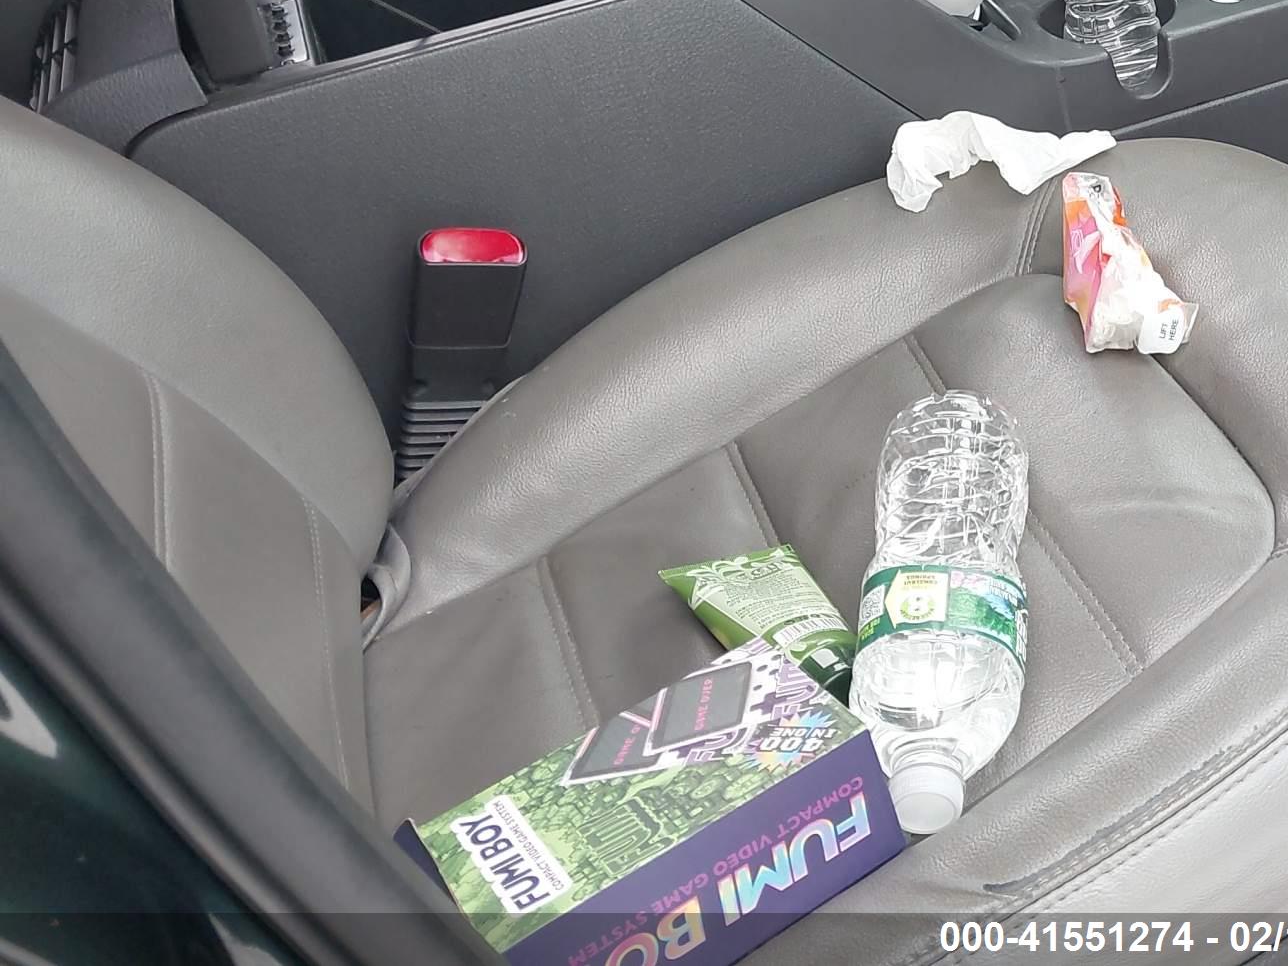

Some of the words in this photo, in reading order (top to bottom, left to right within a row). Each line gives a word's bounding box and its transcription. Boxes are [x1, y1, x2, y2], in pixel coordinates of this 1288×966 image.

[1168, 319, 1179, 341] HERE
[769, 727, 808, 739] ONE
[811, 728, 837, 739] IN
[494, 800, 514, 825] SYSTEM
[777, 775, 864, 839] COMPACT
[459, 814, 514, 861] BOY
[712, 835, 773, 875] VIDEO
[717, 791, 872, 927] FUMI
[490, 853, 550, 911] FUMI
[652, 872, 710, 915] GAME
[567, 911, 648, 966] SYSTEM
[605, 894, 707, 966] BO
